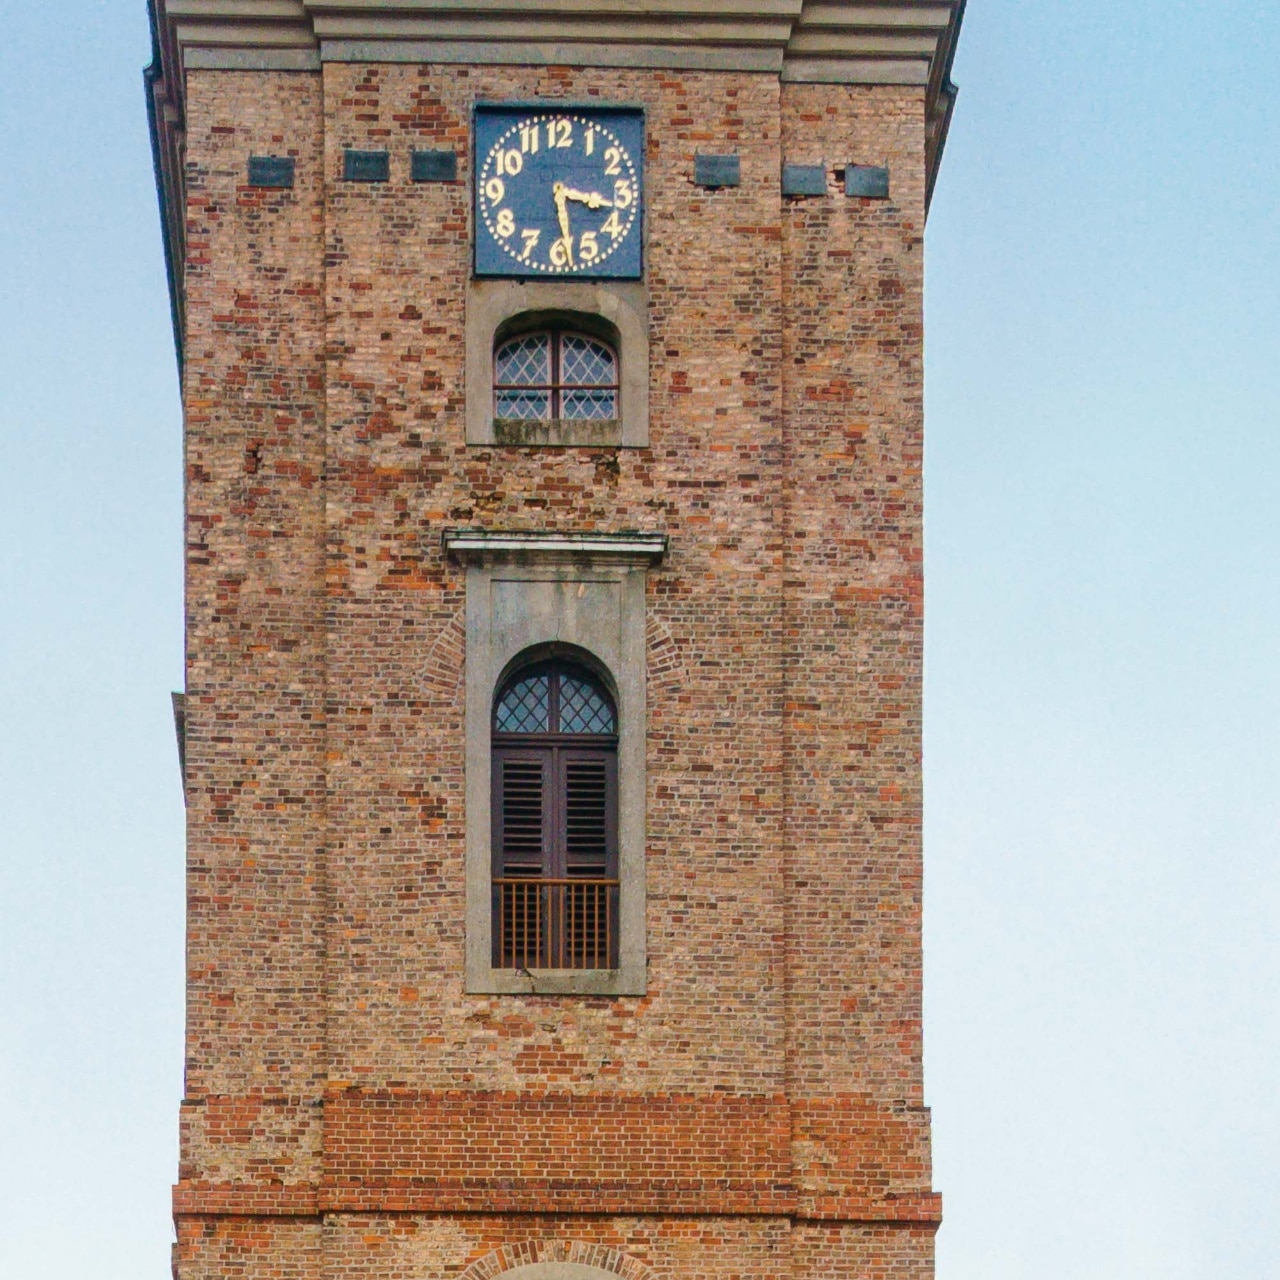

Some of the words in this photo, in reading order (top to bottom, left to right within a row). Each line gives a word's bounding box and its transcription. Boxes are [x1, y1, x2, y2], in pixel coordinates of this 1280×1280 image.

[520, 125, 539, 155] 11
[546, 119, 573, 149] 12
[584, 128, 594, 156] 1
[495, 148, 523, 176] 10
[604, 147, 621, 175] 2
[485, 177, 505, 207] 9
[614, 180, 633, 209] 3
[496, 208, 516, 238] 8
[600, 210, 624, 240] 4
[521, 229, 541, 259] 7
[550, 236, 570, 266] 6
[579, 231, 598, 260] 5
